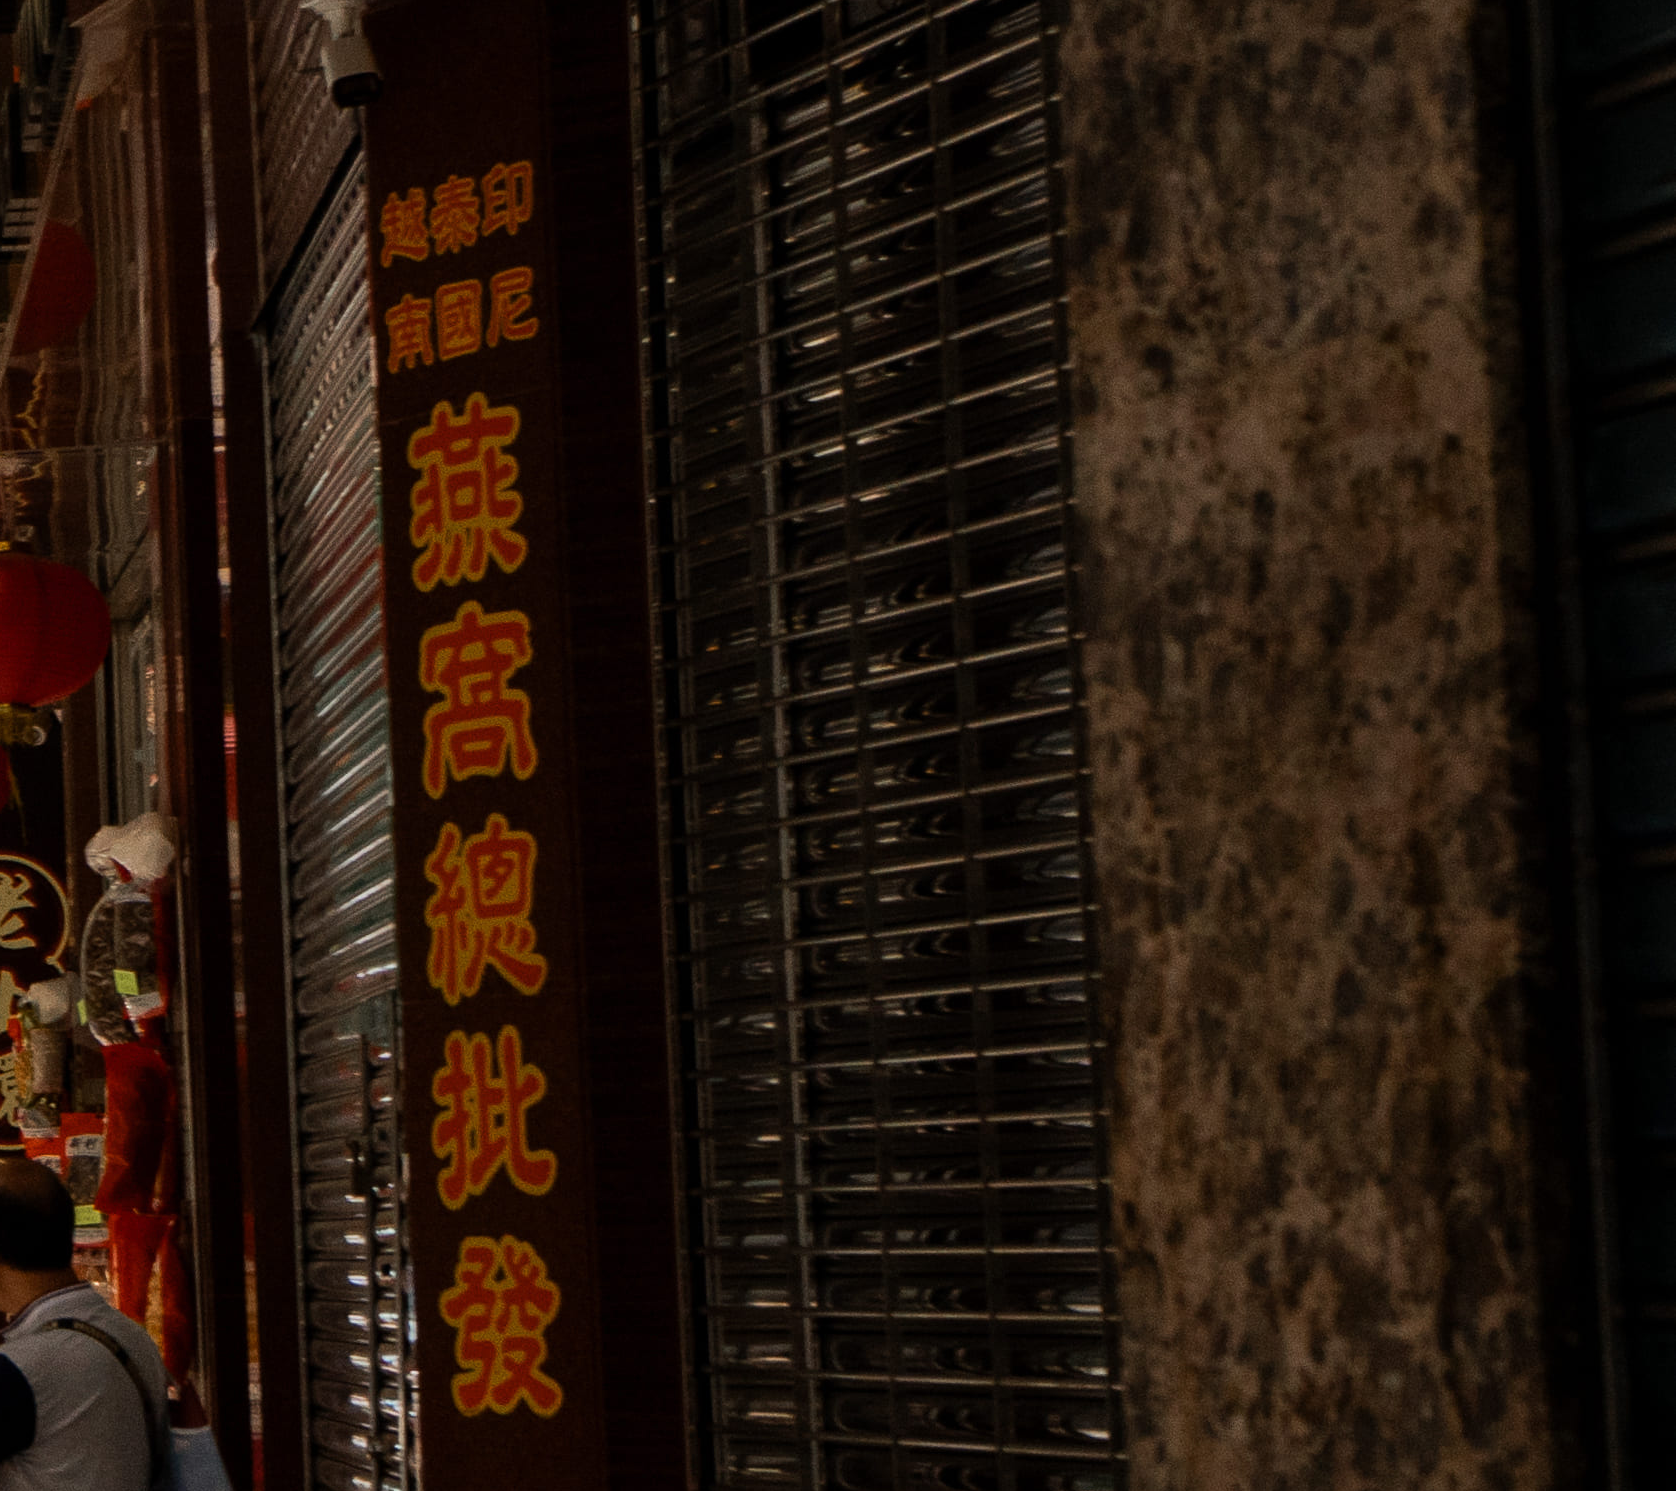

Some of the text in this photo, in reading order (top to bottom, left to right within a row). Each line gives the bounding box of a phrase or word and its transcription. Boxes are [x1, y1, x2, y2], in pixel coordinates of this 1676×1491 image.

[407, 390, 563, 1420] 燕窩總批發
